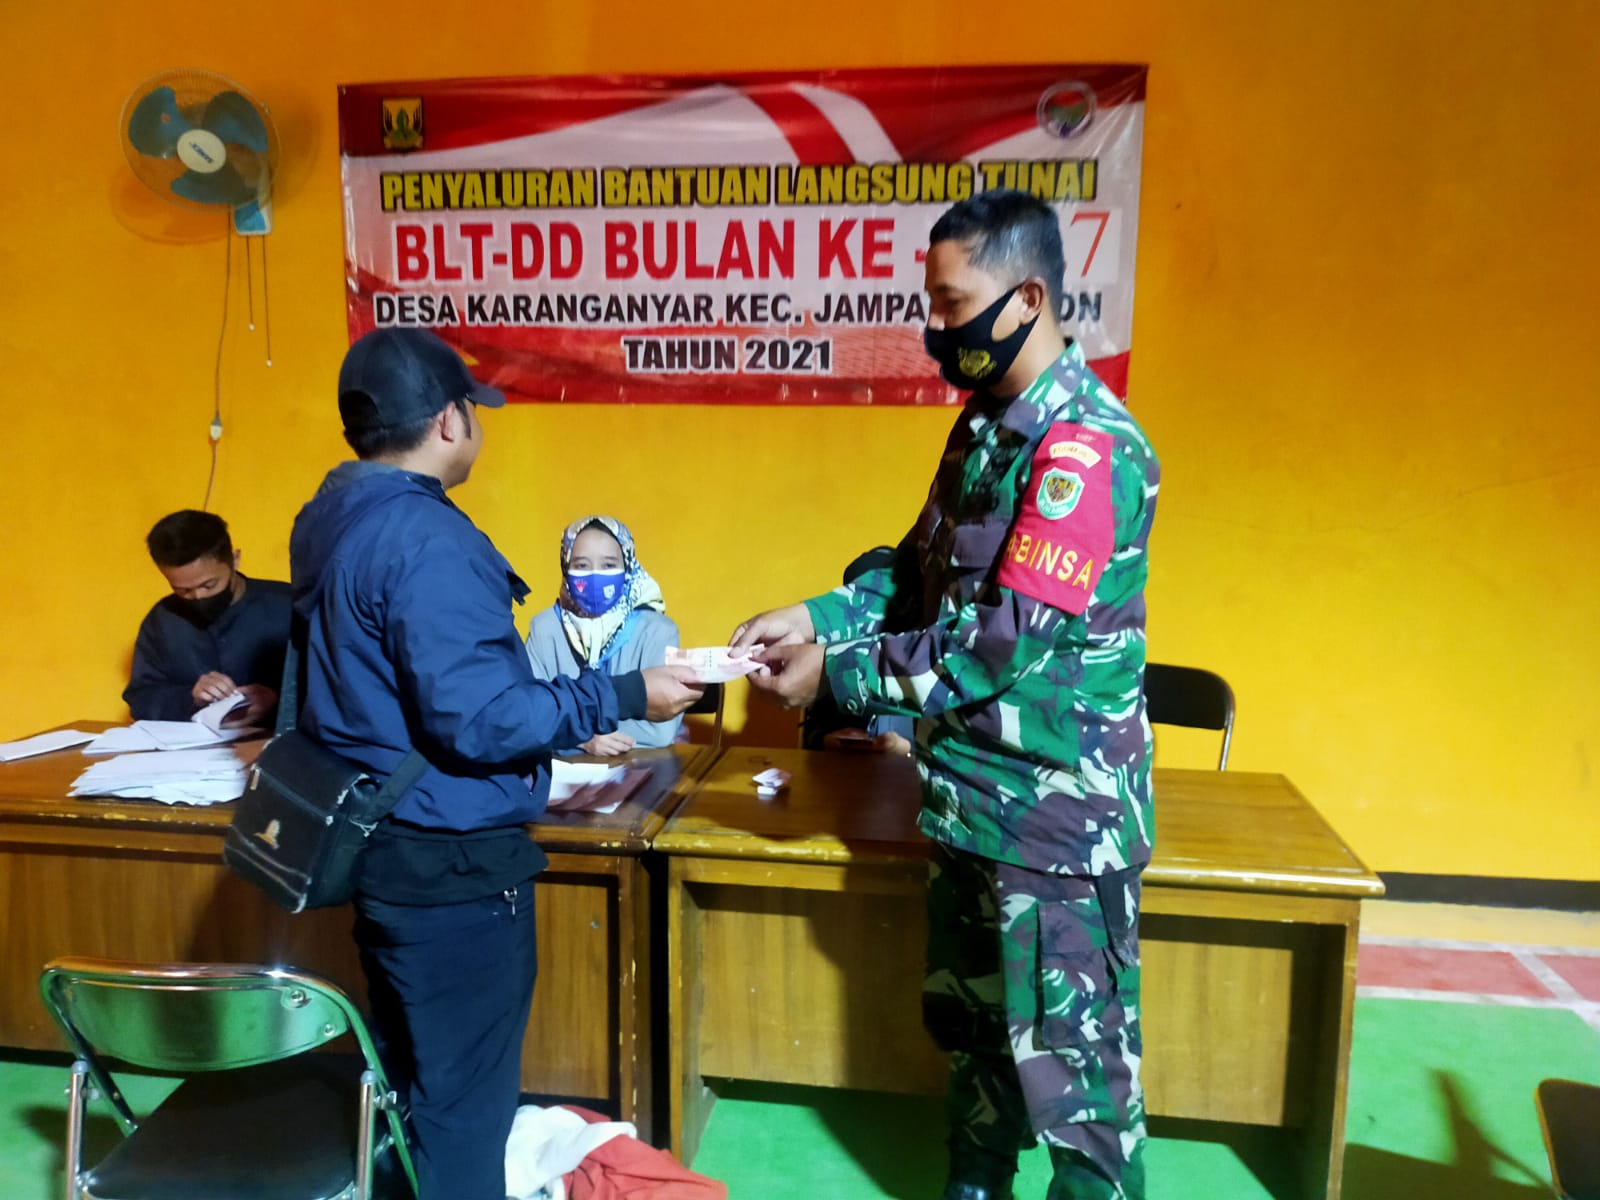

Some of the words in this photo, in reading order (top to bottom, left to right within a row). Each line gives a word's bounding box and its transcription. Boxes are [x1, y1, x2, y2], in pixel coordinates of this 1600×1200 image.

[380, 168, 597, 211] PENYALURAN
[601, 165, 770, 207] BANTUAN
[775, 163, 974, 205] LANGSUNG
[978, 159, 1098, 203] TUNAI
[395, 221, 583, 281] BLT-DD
[605, 219, 795, 280] BULAN
[818, 218, 895, 279] KE
[375, 294, 457, 323] DESA
[468, 293, 714, 323] KARANGANYAR
[725, 293, 802, 323] KEC.
[814, 293, 926, 323] JAMPA
[624, 338, 736, 371] TAHUN
[745, 338, 831, 371] 2021
[1007, 532, 1094, 591] ABINSA
